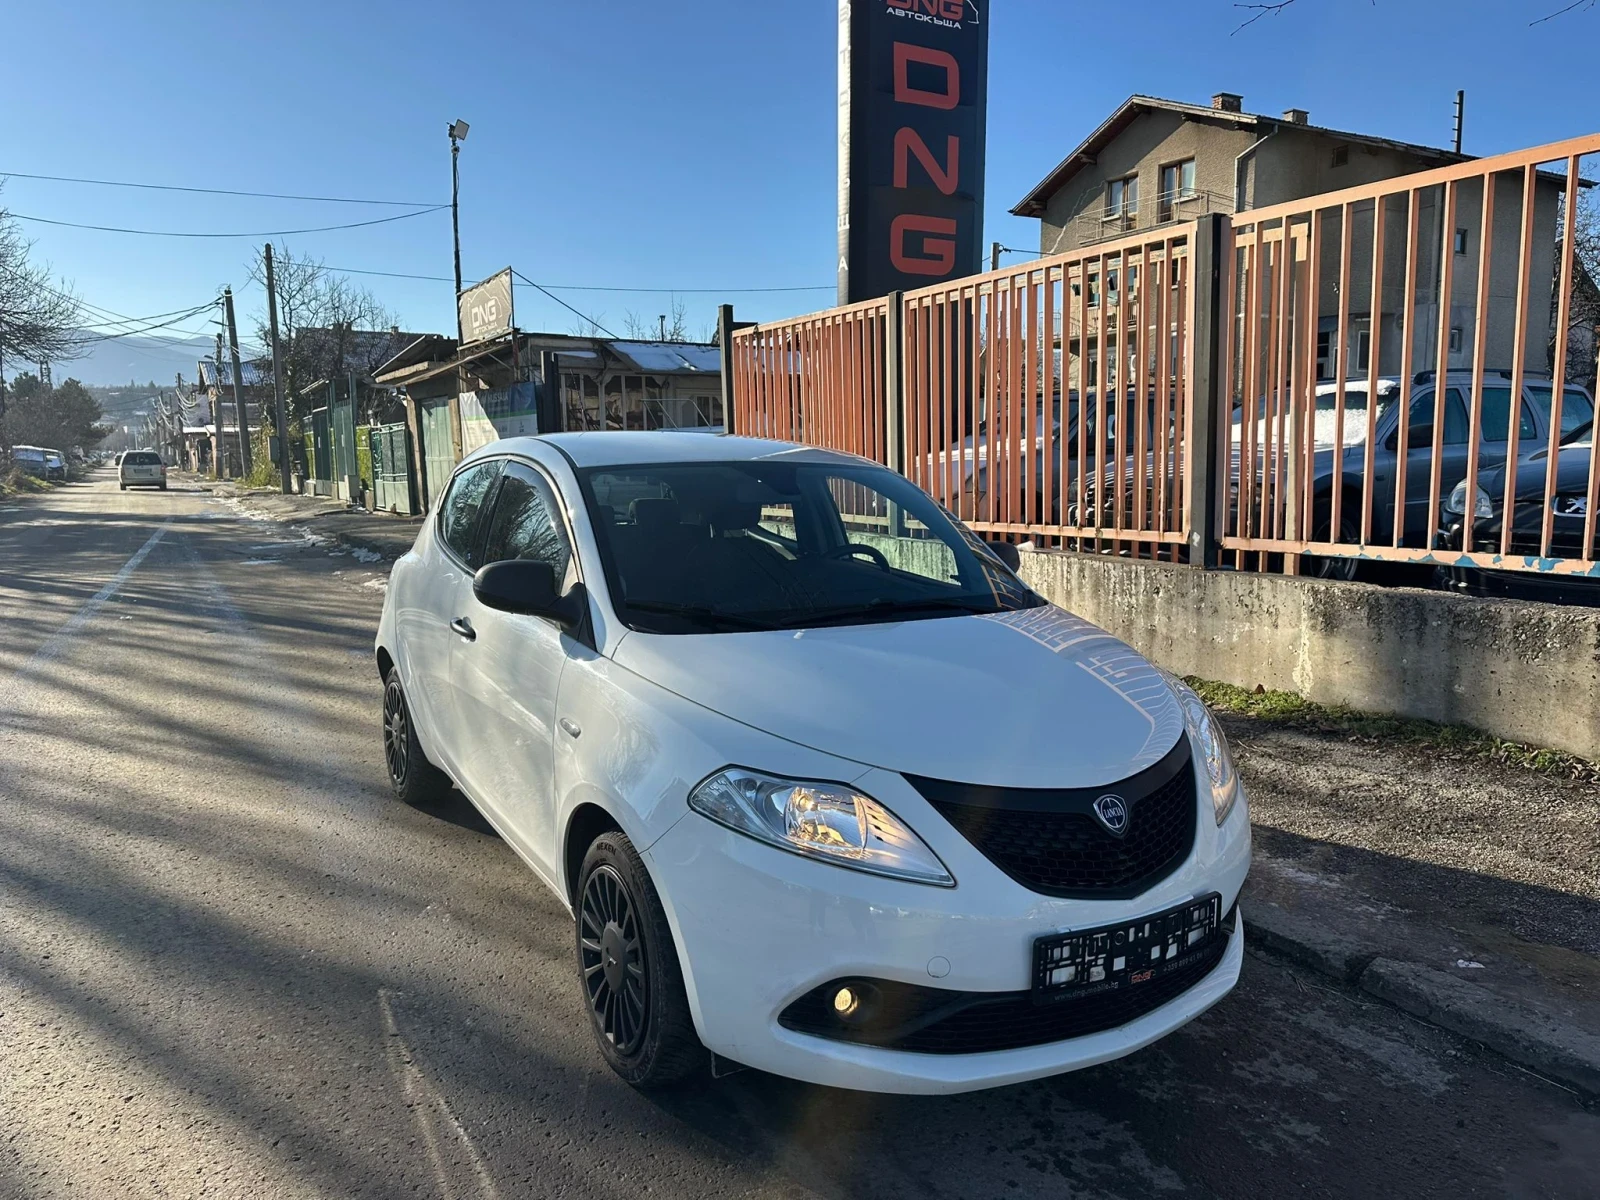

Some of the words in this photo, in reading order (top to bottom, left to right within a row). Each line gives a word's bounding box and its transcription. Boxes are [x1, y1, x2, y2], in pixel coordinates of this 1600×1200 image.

[886, 7, 962, 30] АВТОКЪША
[890, 41, 959, 276] DNG
[471, 299, 497, 327] DNG
[596, 842, 617, 856] NEXEN
